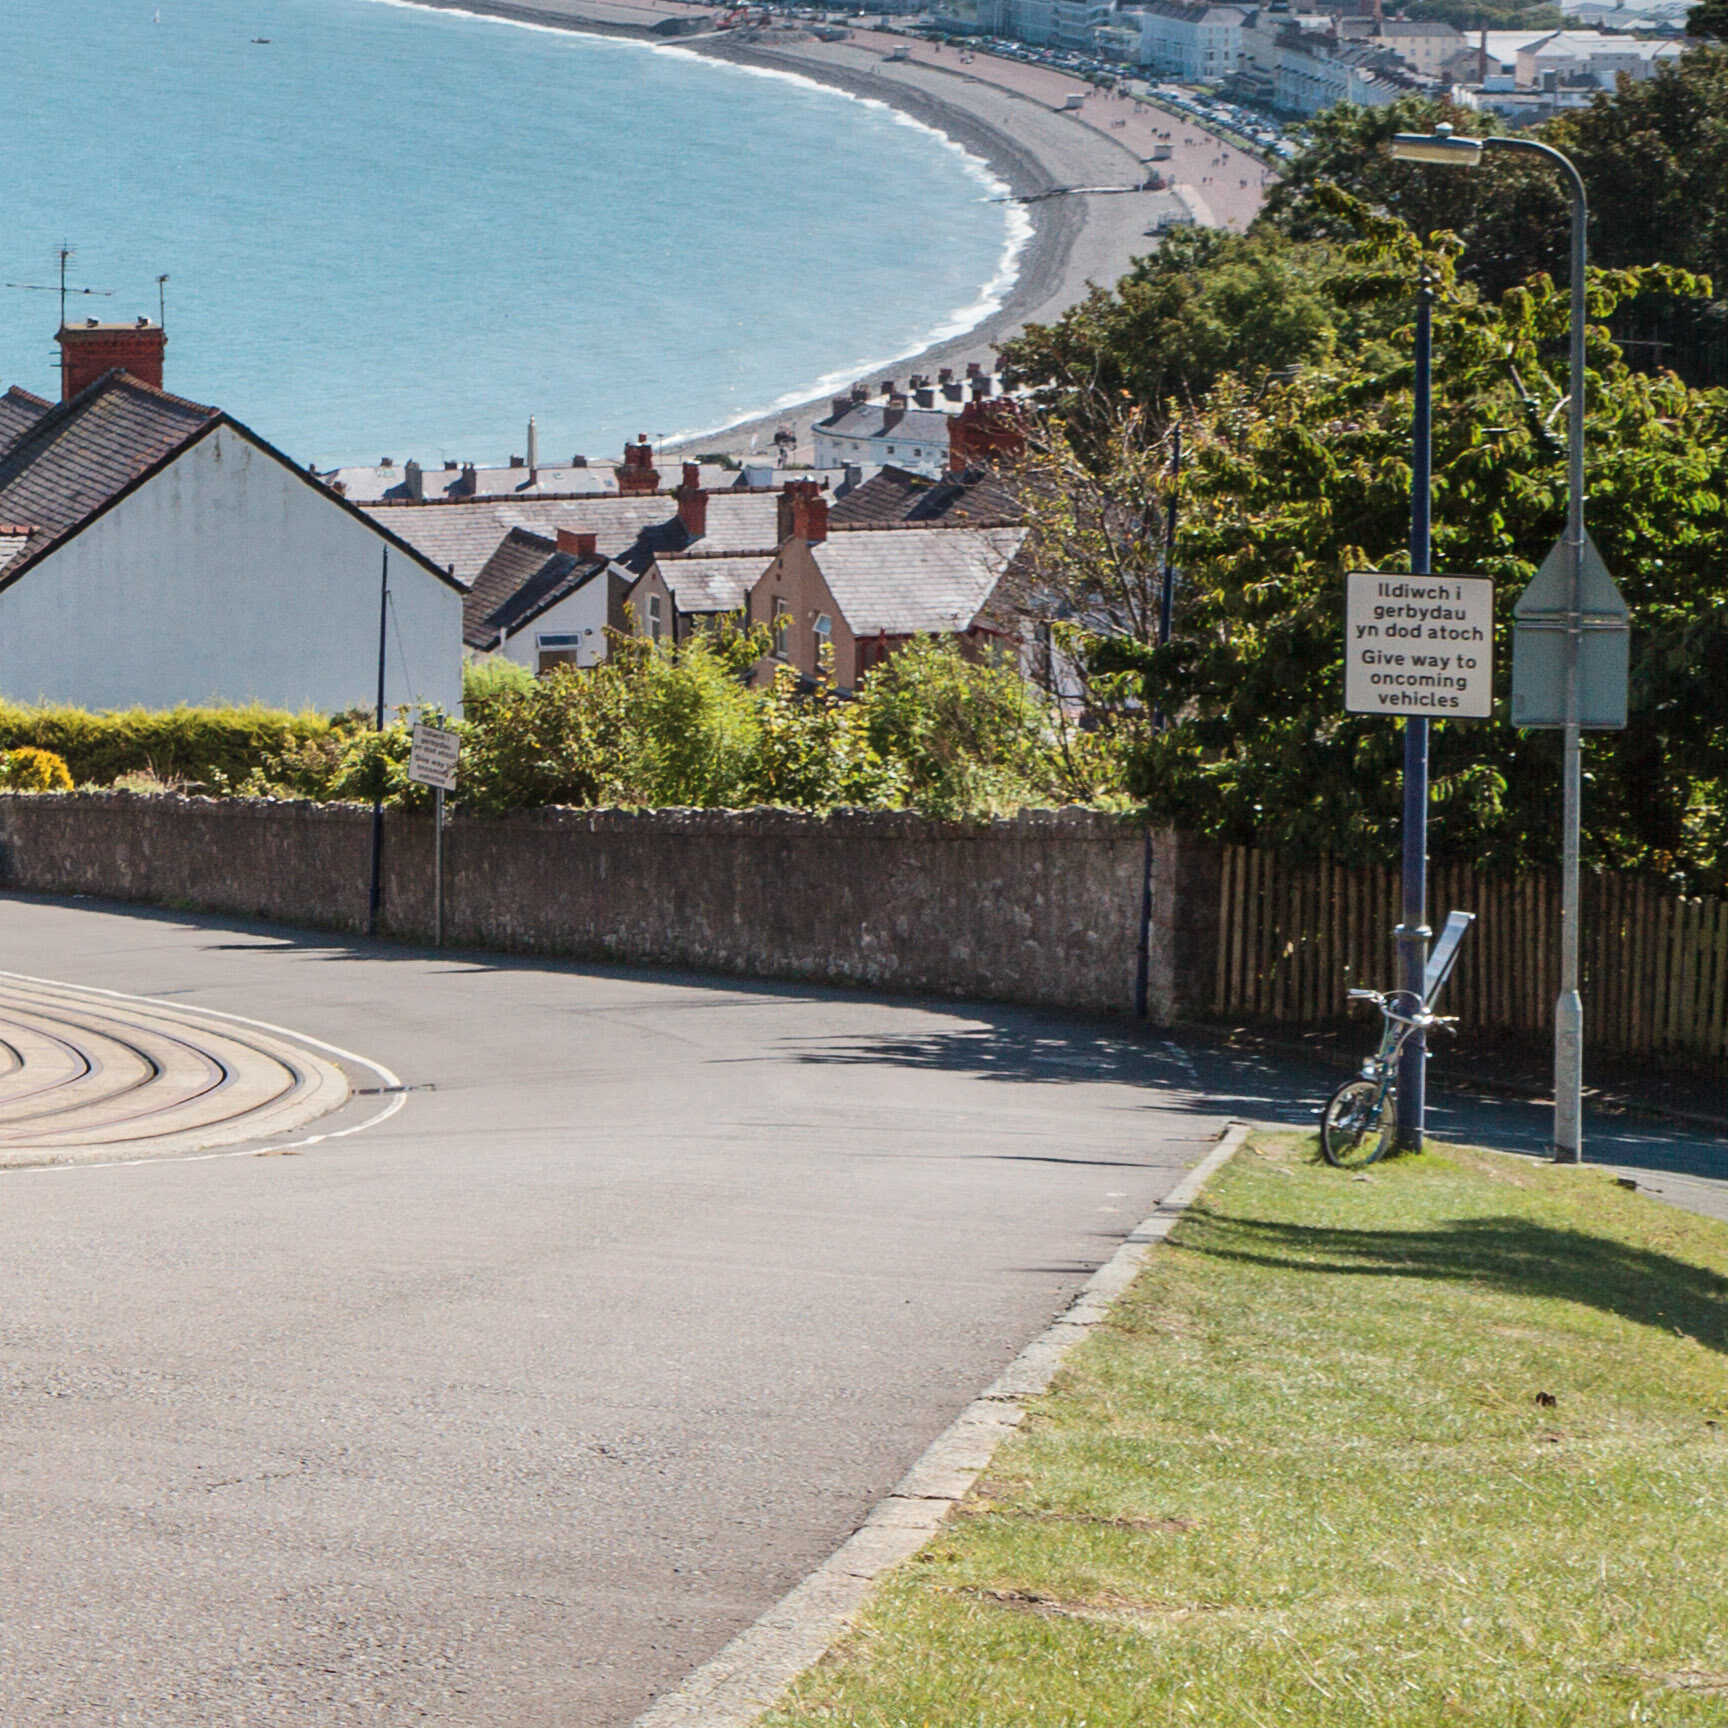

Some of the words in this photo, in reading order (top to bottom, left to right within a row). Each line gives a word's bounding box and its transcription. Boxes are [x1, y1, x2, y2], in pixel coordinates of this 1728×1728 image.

[1378, 582, 1450, 600] Ildiwch
[1456, 586, 1462, 601] i
[1373, 604, 1466, 621] gerbydau
[1356, 624, 1379, 639] yn
[1385, 623, 1422, 639] dod
[1427, 626, 1484, 641] atoch
[1362, 649, 1405, 666] Give
[1412, 655, 1450, 671] way
[1456, 654, 1477, 670] to
[1370, 672, 1467, 691] oncoming
[1378, 690, 1460, 708] vehicles
